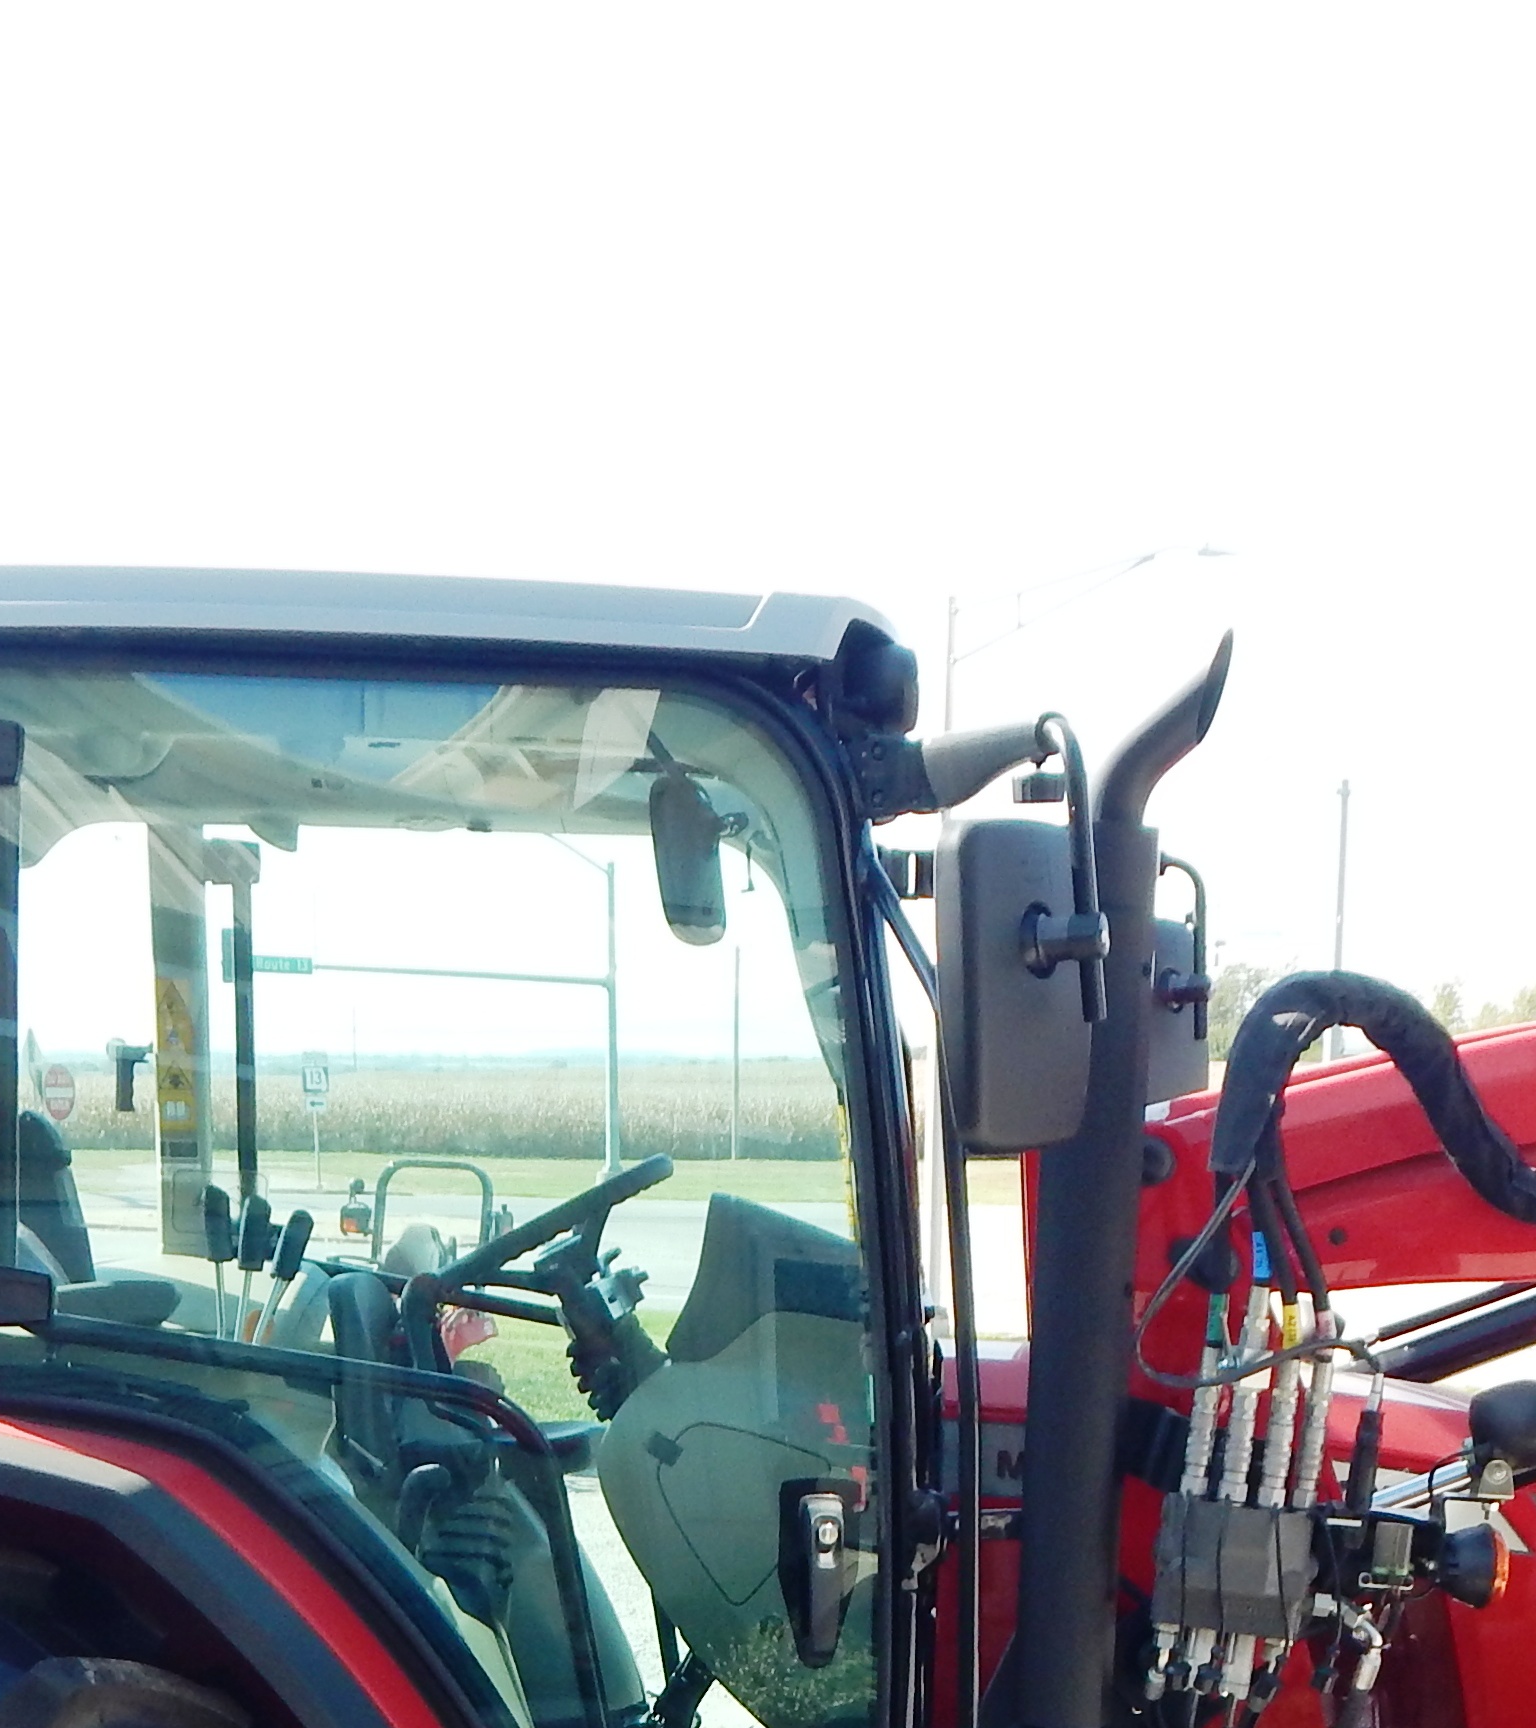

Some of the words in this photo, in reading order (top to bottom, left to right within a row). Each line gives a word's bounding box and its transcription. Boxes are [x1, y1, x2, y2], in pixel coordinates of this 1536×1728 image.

[256, 956, 291, 970] Route
[297, 958, 309, 971] 13
[310, 1070, 322, 1085] 13
